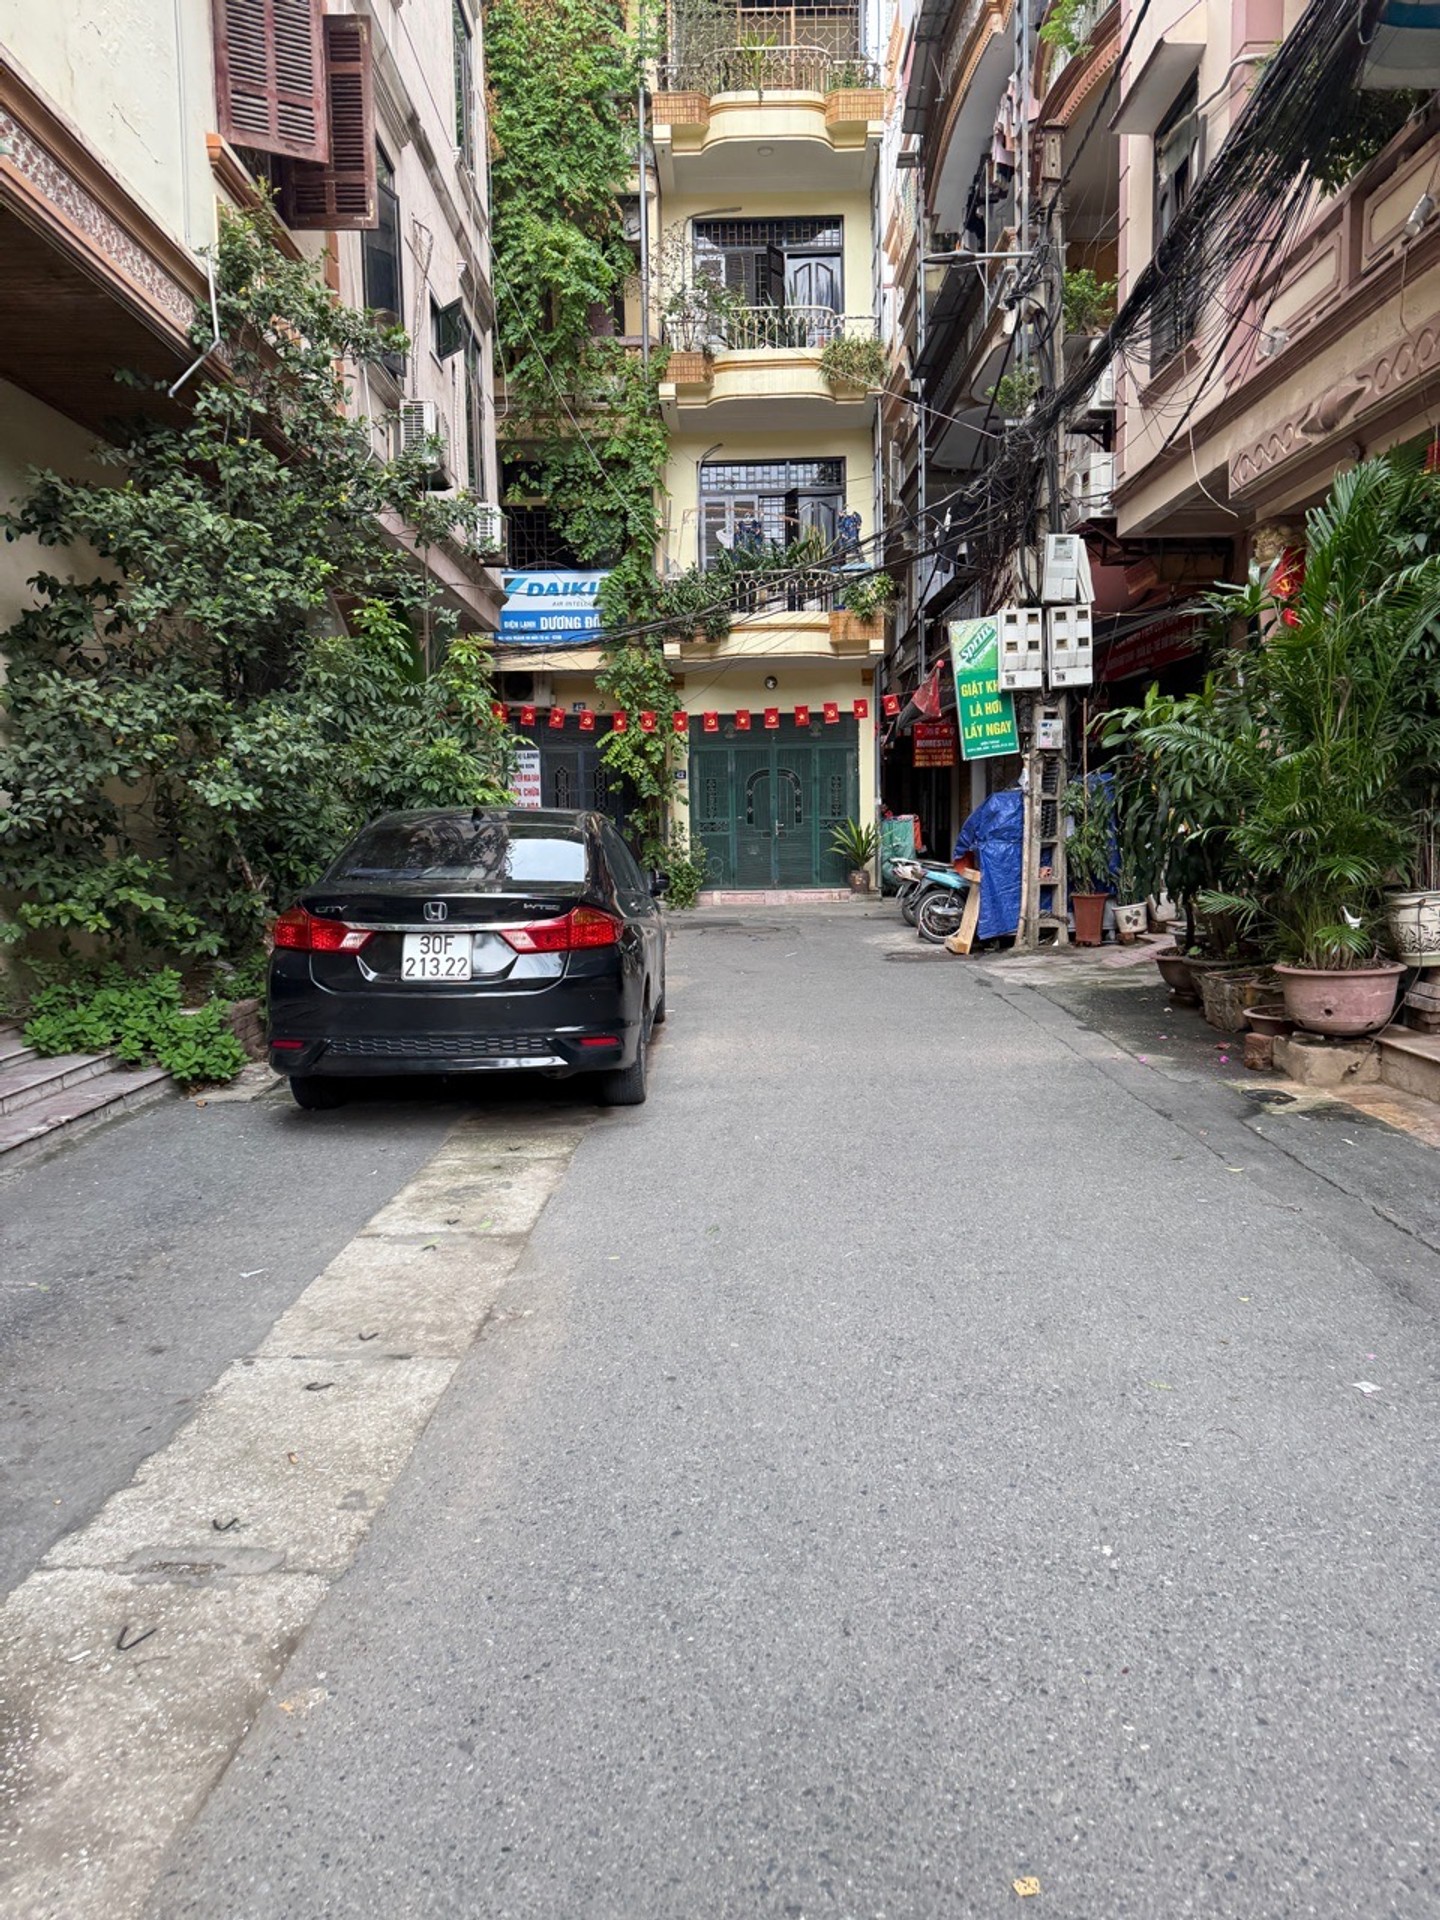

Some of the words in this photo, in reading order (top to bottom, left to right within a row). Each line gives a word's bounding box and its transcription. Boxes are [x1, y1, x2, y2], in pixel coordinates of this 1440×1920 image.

[526, 582, 598, 597] DAIKI
[540, 615, 582, 630] DƯƠNG
[961, 681, 984, 698] GIẶT
[969, 701, 983, 717] LÀ
[964, 721, 983, 740] LẤY
[985, 720, 1012, 737] NGAY
[420, 935, 455, 955] 30F
[405, 957, 468, 977] 213.22
